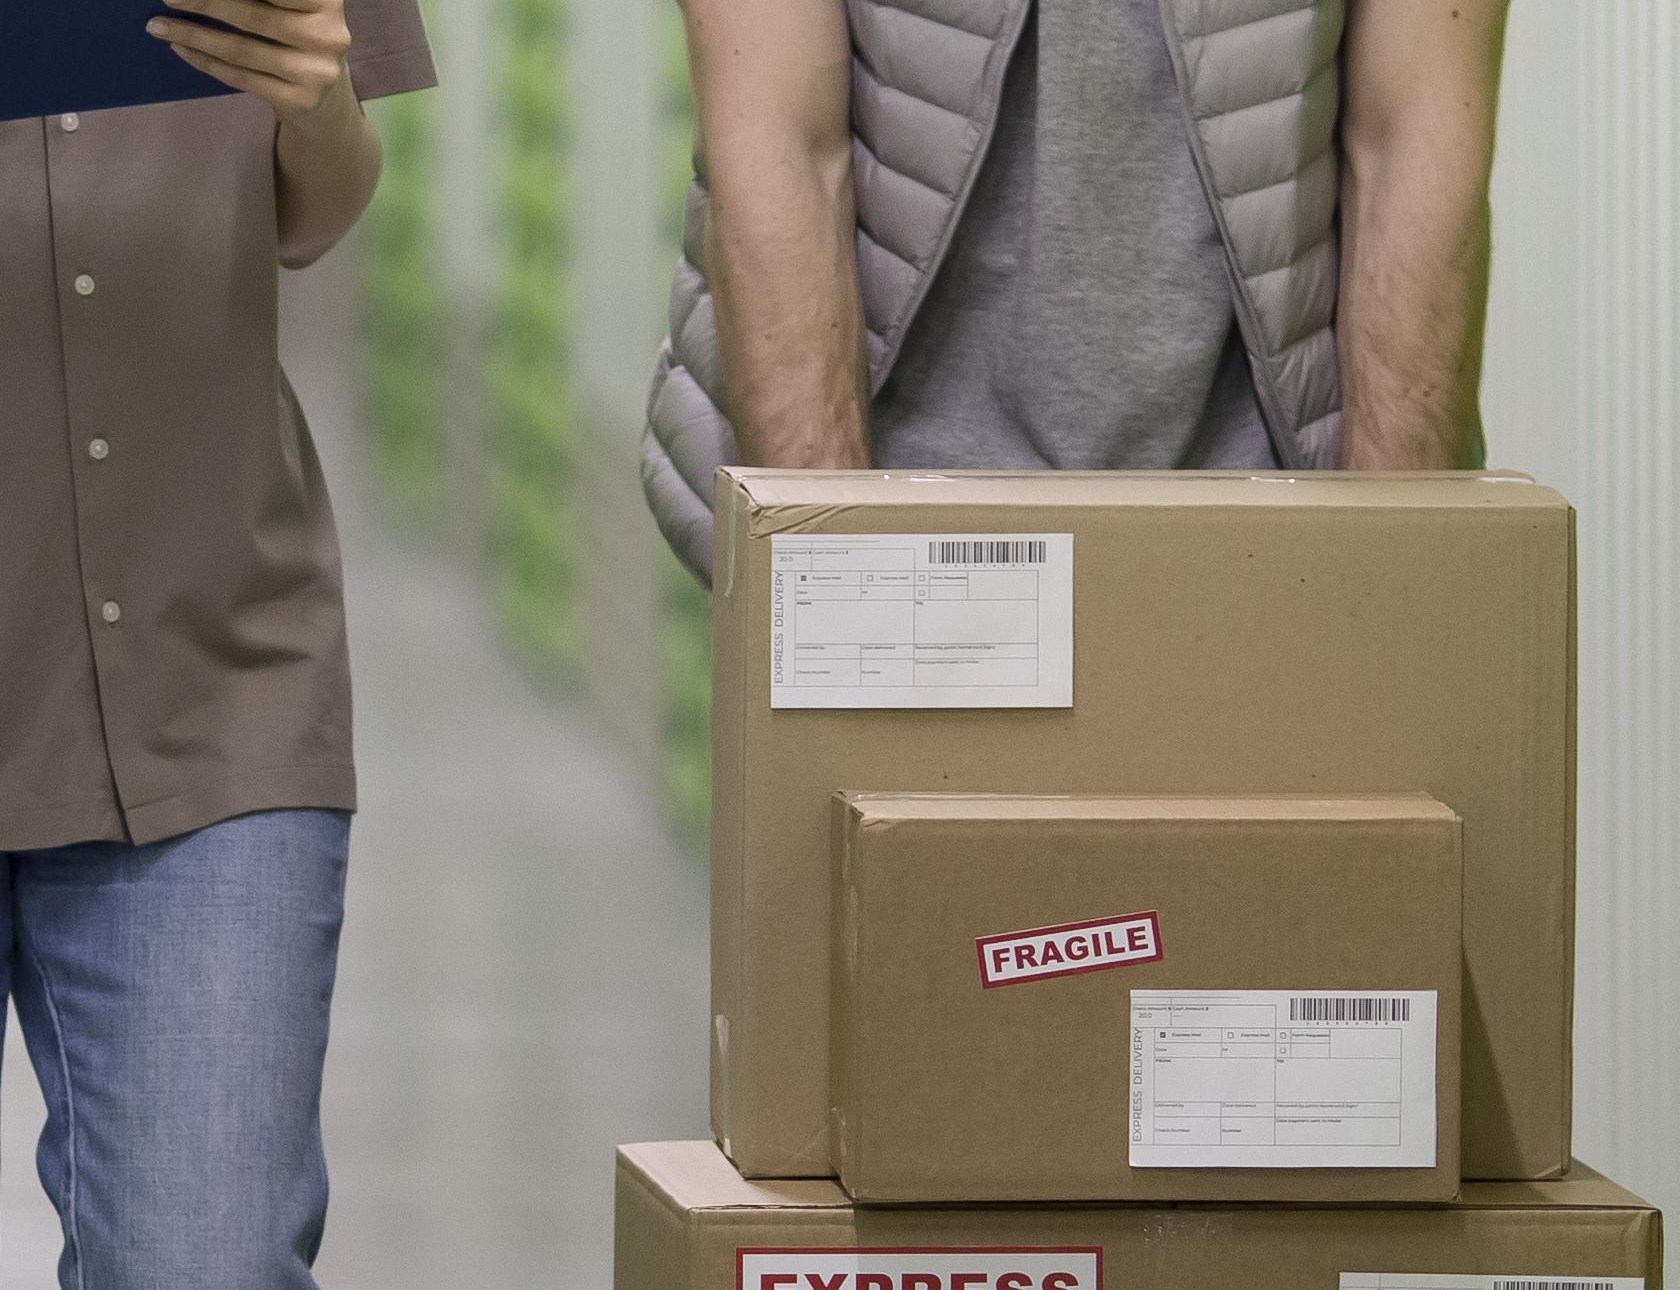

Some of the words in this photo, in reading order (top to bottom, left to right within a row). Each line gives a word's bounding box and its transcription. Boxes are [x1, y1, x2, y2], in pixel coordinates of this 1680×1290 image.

[774, 570, 784, 628] DELIVERY
[774, 632, 784, 684] EXPRESS
[991, 925, 1149, 974] FRAGILE
[1133, 1027, 1143, 1085] DELIVERY
[1132, 1090, 1143, 1142] EXPRESS
